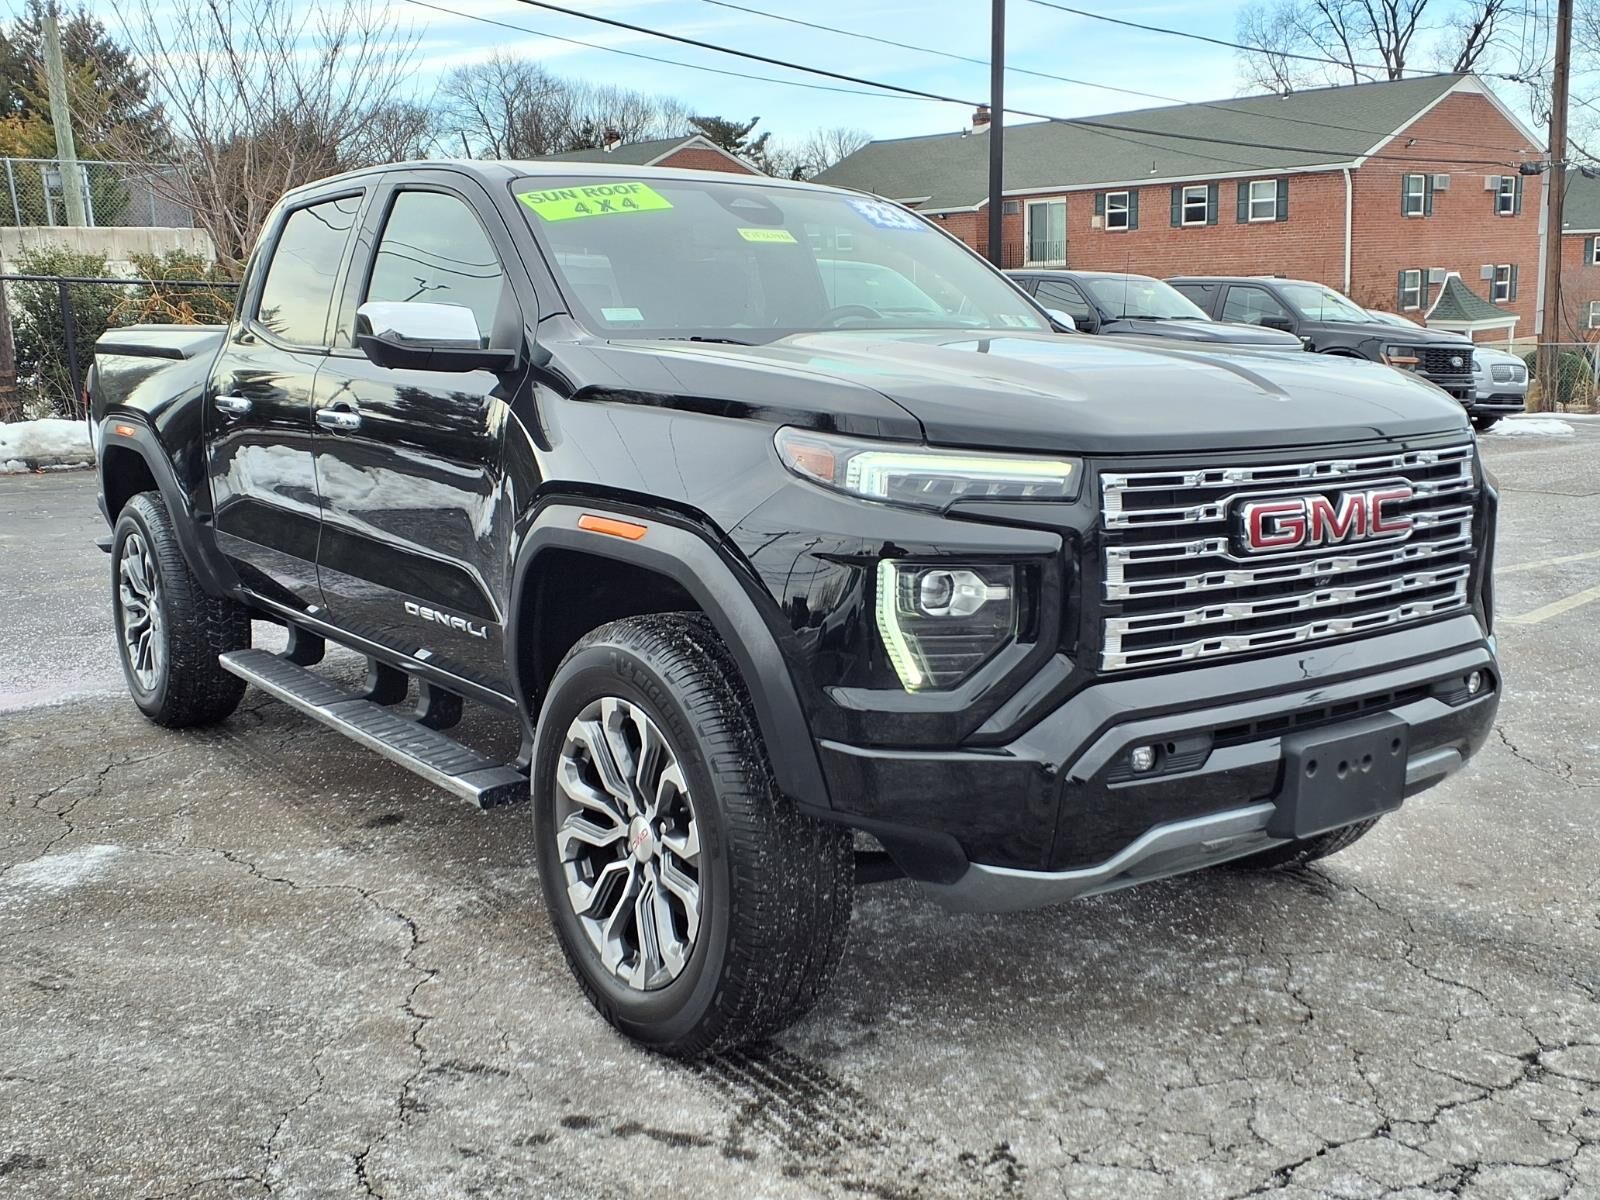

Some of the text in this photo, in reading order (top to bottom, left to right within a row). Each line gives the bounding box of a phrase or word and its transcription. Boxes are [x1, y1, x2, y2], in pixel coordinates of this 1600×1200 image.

[527, 184, 642, 204] SUN ROOF
[1243, 486, 1415, 552] GMC
[404, 601, 488, 640] DENALI
